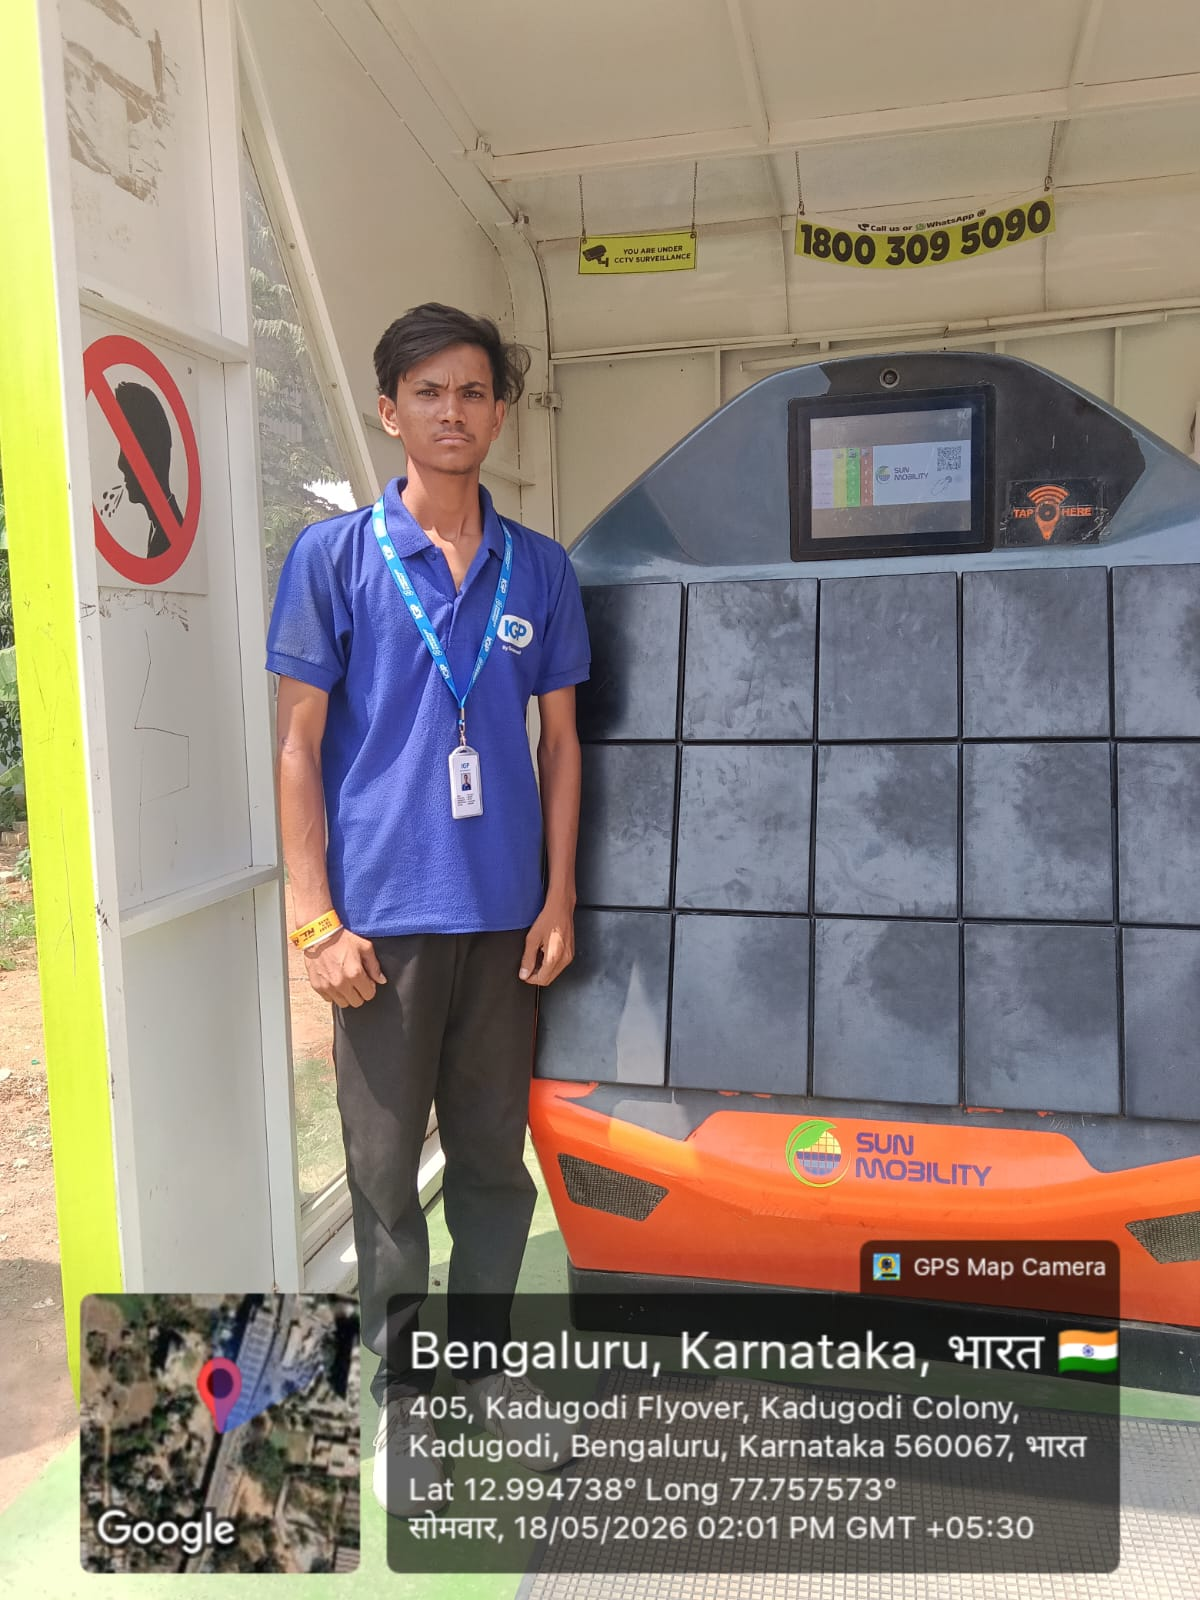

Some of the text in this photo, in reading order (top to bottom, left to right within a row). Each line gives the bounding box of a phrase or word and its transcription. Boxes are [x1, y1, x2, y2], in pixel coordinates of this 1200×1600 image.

[870, 223, 887, 232] Call
[926, 213, 975, 229] WhatsApp
[800, 200, 1052, 266] 1800 309 5090
[640, 247, 656, 255] ARE
[657, 245, 683, 253] UNDER
[614, 252, 691, 264] CCTV SURVEILLANCE
[893, 466, 910, 474] SUN
[893, 472, 929, 481] MOBILITY
[1013, 507, 1093, 519] TAP HERE
[504, 619, 527, 641] IGP
[855, 1131, 915, 1157] SUN
[855, 1156, 993, 1188] MOBILITY
